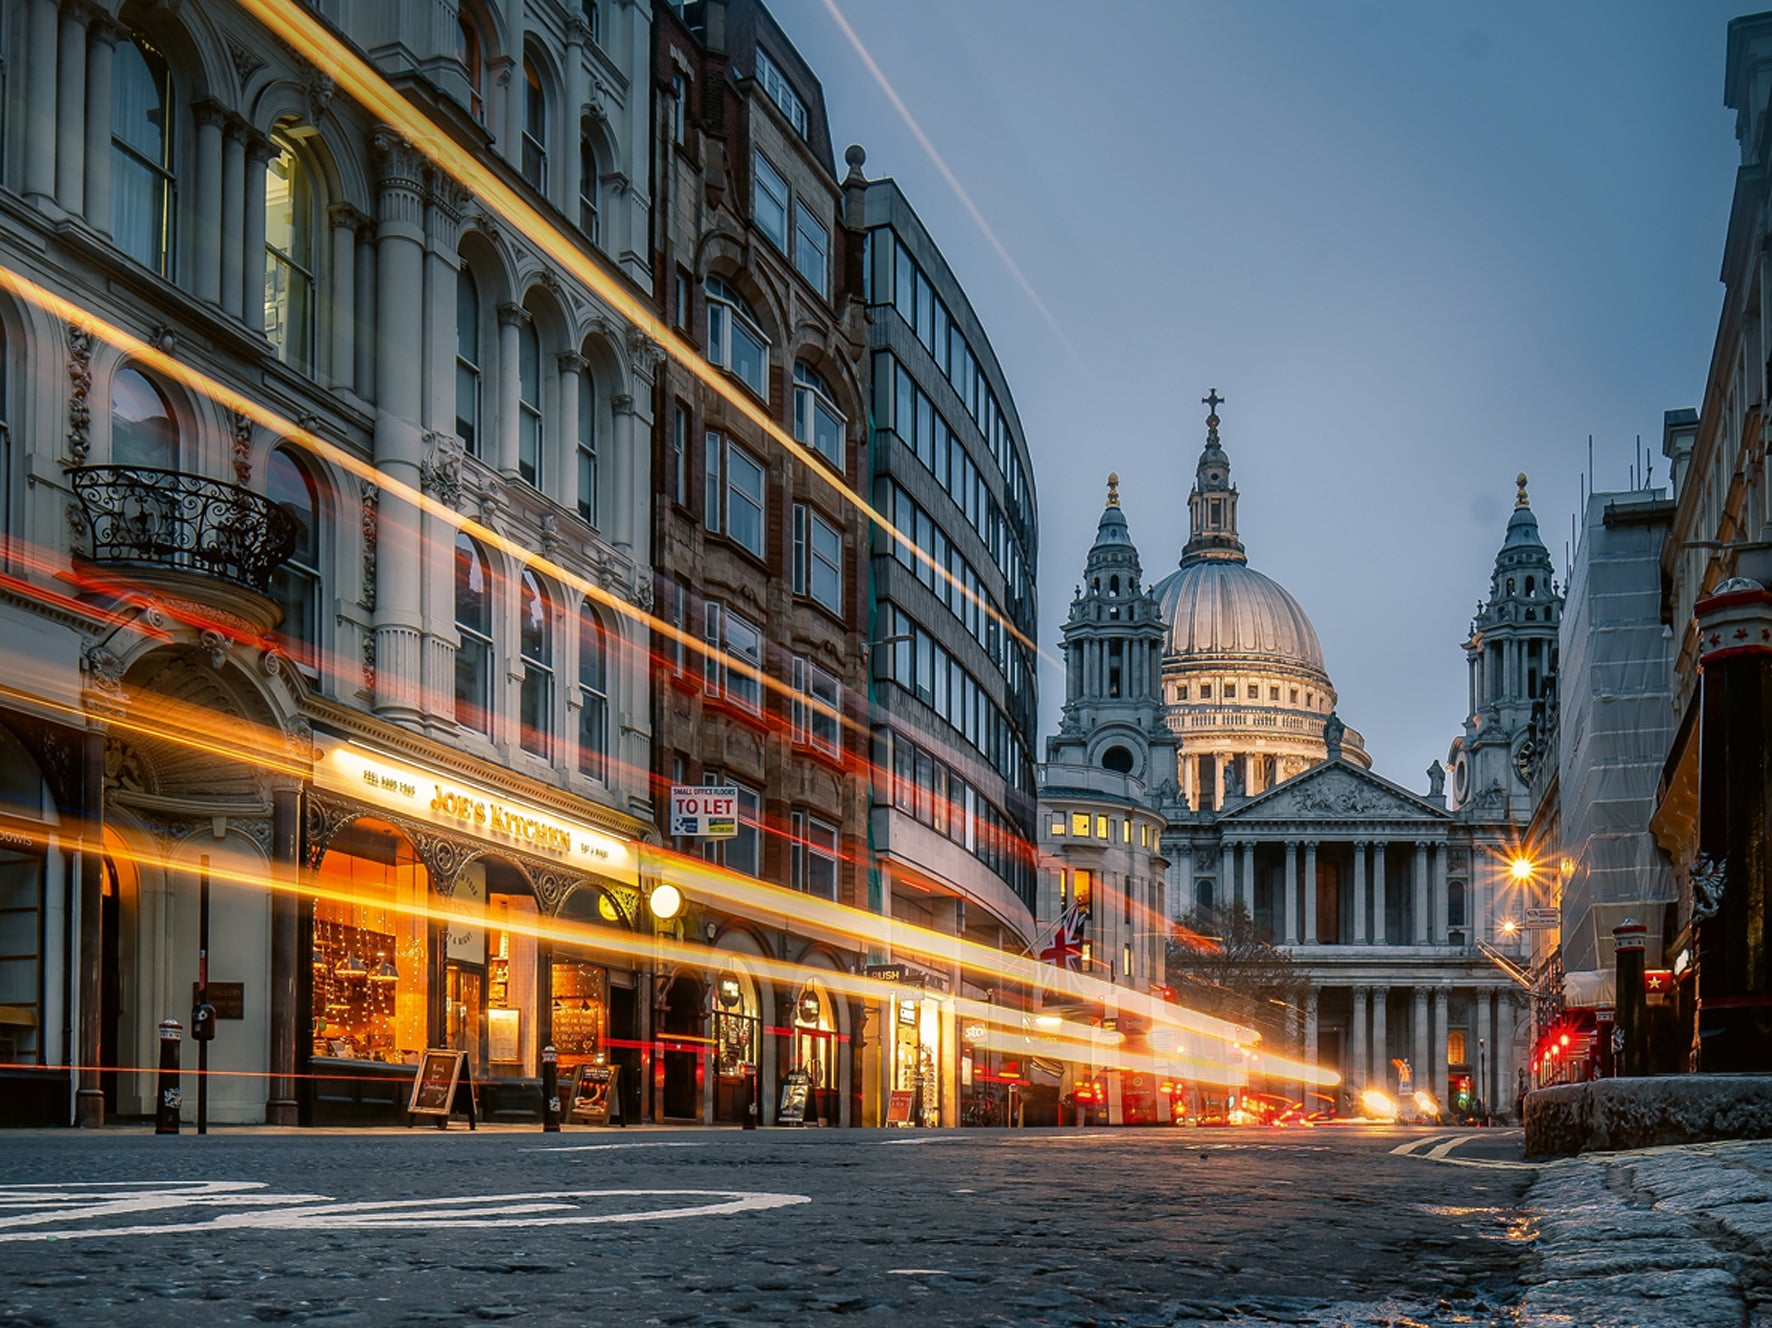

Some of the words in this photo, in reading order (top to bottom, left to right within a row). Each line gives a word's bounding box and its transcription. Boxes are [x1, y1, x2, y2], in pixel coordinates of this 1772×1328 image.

[673, 788, 692, 796] SMALL
[694, 788, 712, 796] OFFICE
[713, 788, 736, 796] FLOORS
[676, 798, 699, 815] TO
[703, 798, 734, 815] LET
[430, 785, 486, 823] JOE'S
[490, 804, 571, 852] KITCHEN
